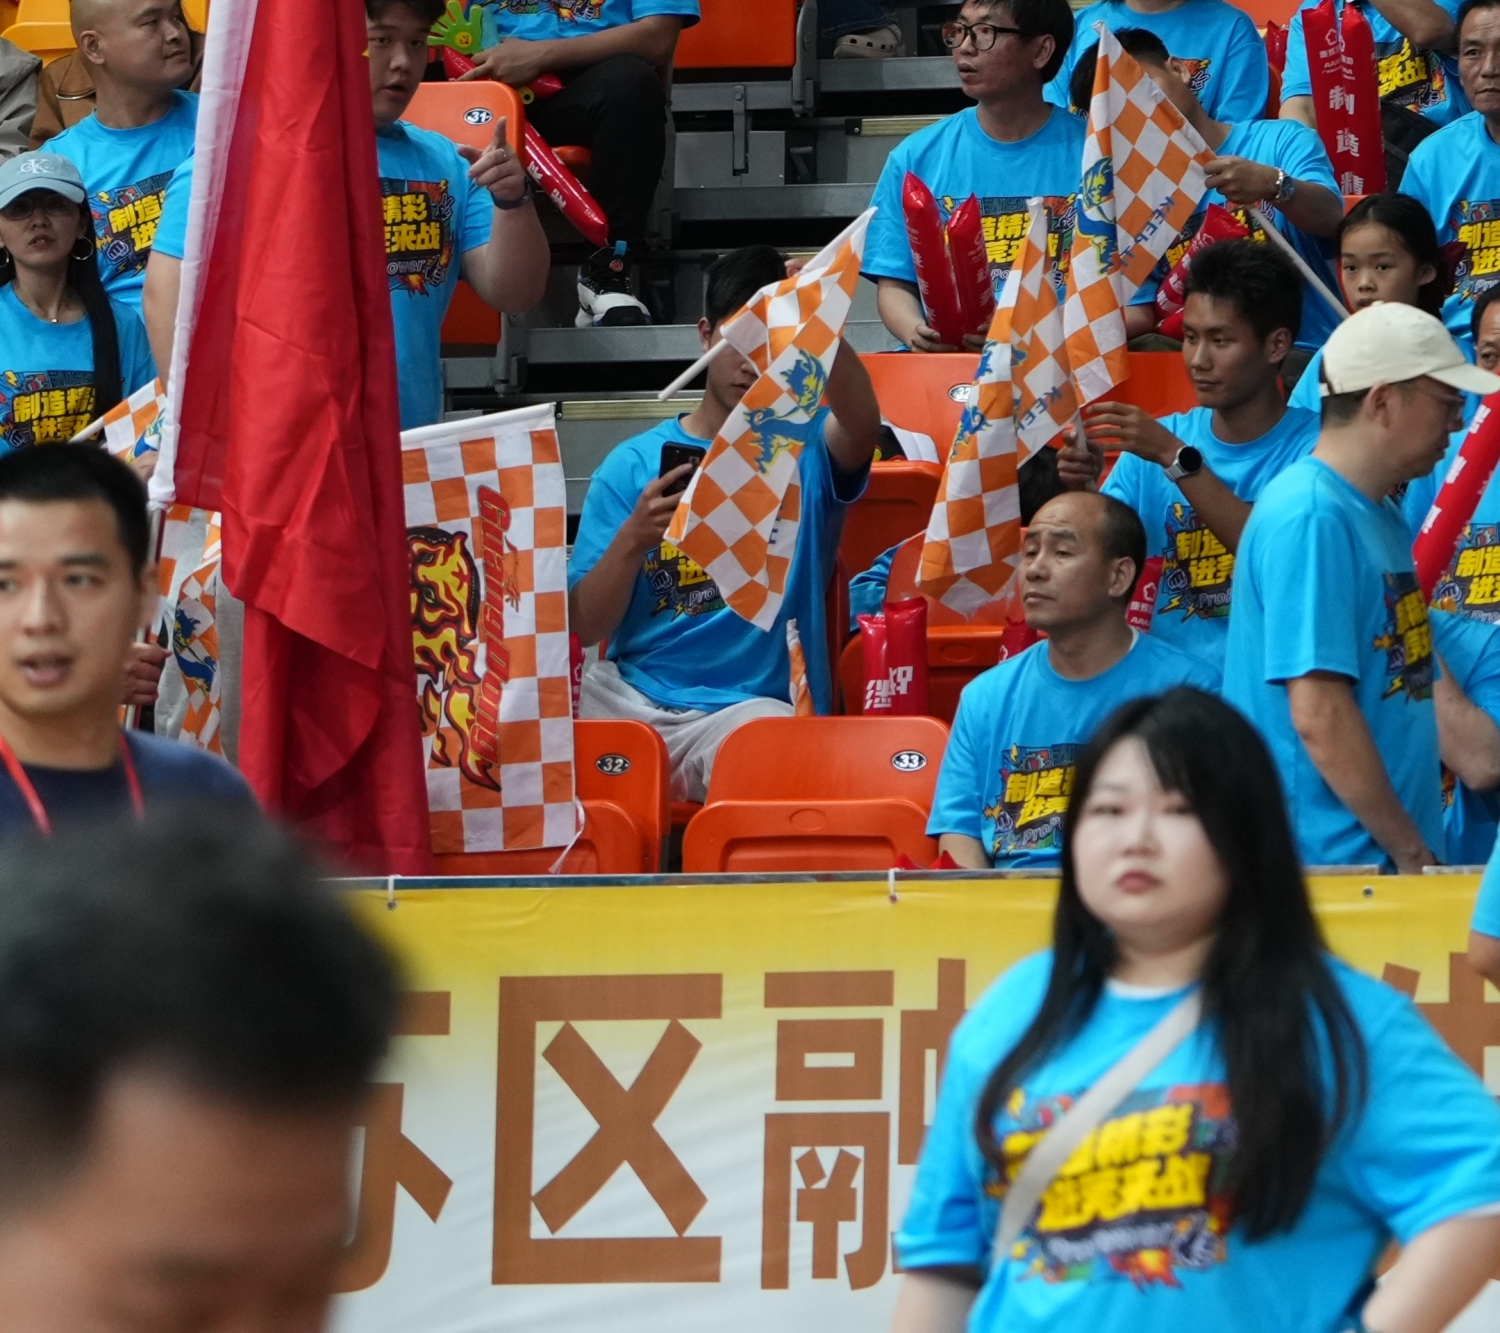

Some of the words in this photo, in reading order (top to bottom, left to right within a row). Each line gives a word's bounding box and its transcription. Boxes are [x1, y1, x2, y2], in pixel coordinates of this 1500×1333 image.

[468, 112, 486, 122] 31
[603, 757, 623, 772] 32
[900, 754, 919, 768] 33
